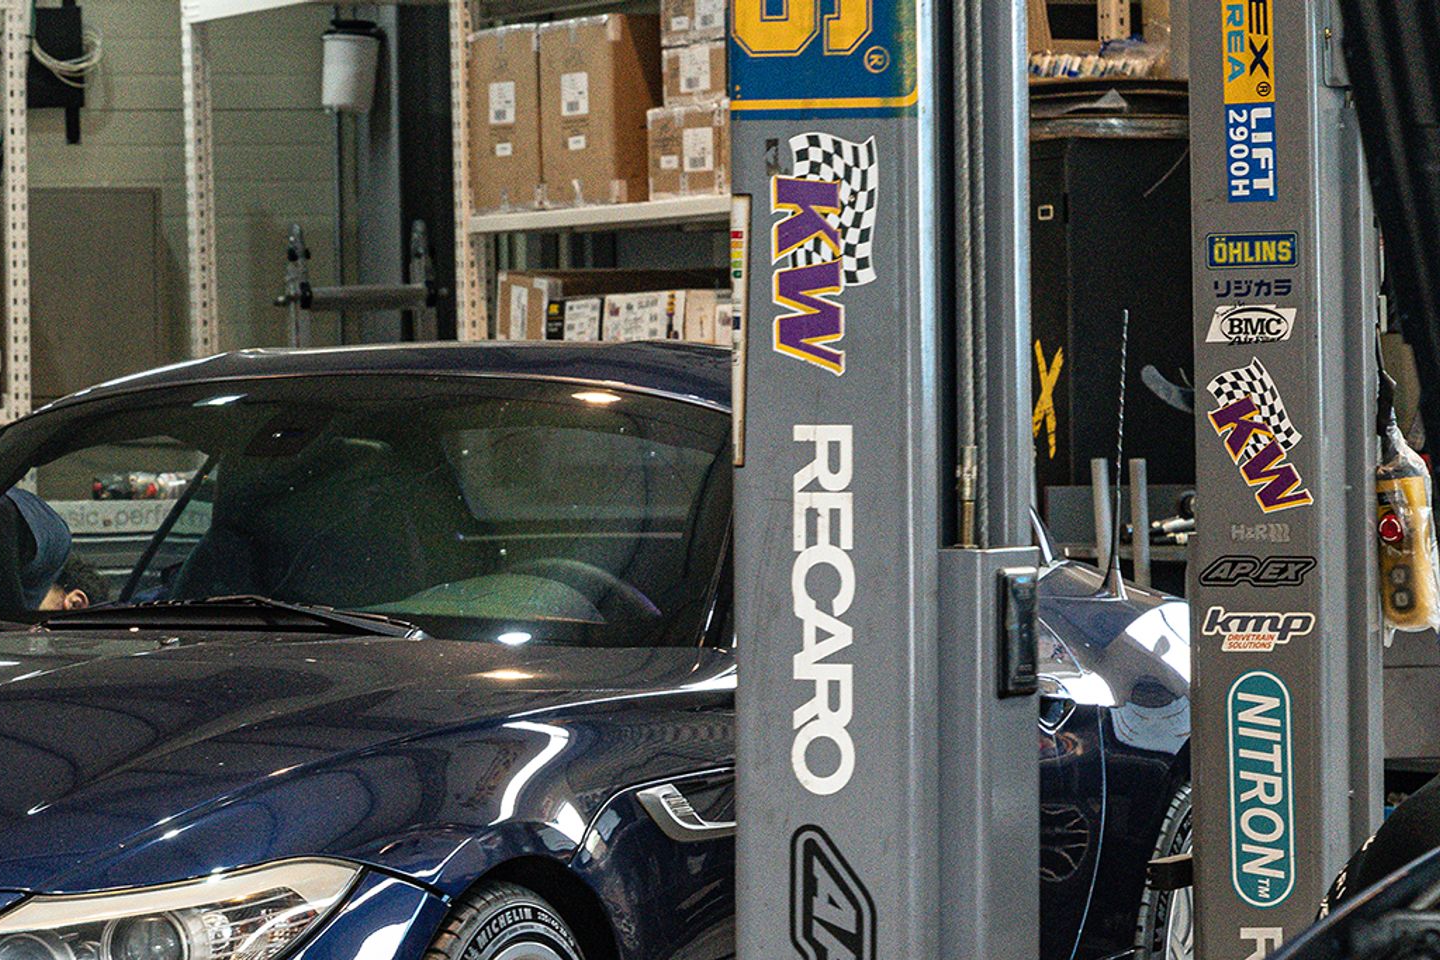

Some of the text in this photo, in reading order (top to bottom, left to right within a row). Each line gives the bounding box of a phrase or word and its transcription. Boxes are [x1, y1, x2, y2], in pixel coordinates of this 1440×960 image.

[1228, 108, 1250, 197] 2900H
[1250, 106, 1274, 196] LIFT
[1214, 237, 1292, 263] ÖHLINS
[771, 174, 846, 376] KW
[1213, 279, 1292, 297] リジカラ
[1227, 317, 1281, 335] BMC
[1207, 395, 1314, 513] KW
[1203, 558, 1312, 584] APEX
[791, 424, 856, 795] RECARO
[1204, 609, 1312, 641] kmp
[1227, 633, 1276, 641] DRIVETRAIN
[1237, 691, 1286, 880] NITRON
[476, 907, 533, 949] MICHELIN
